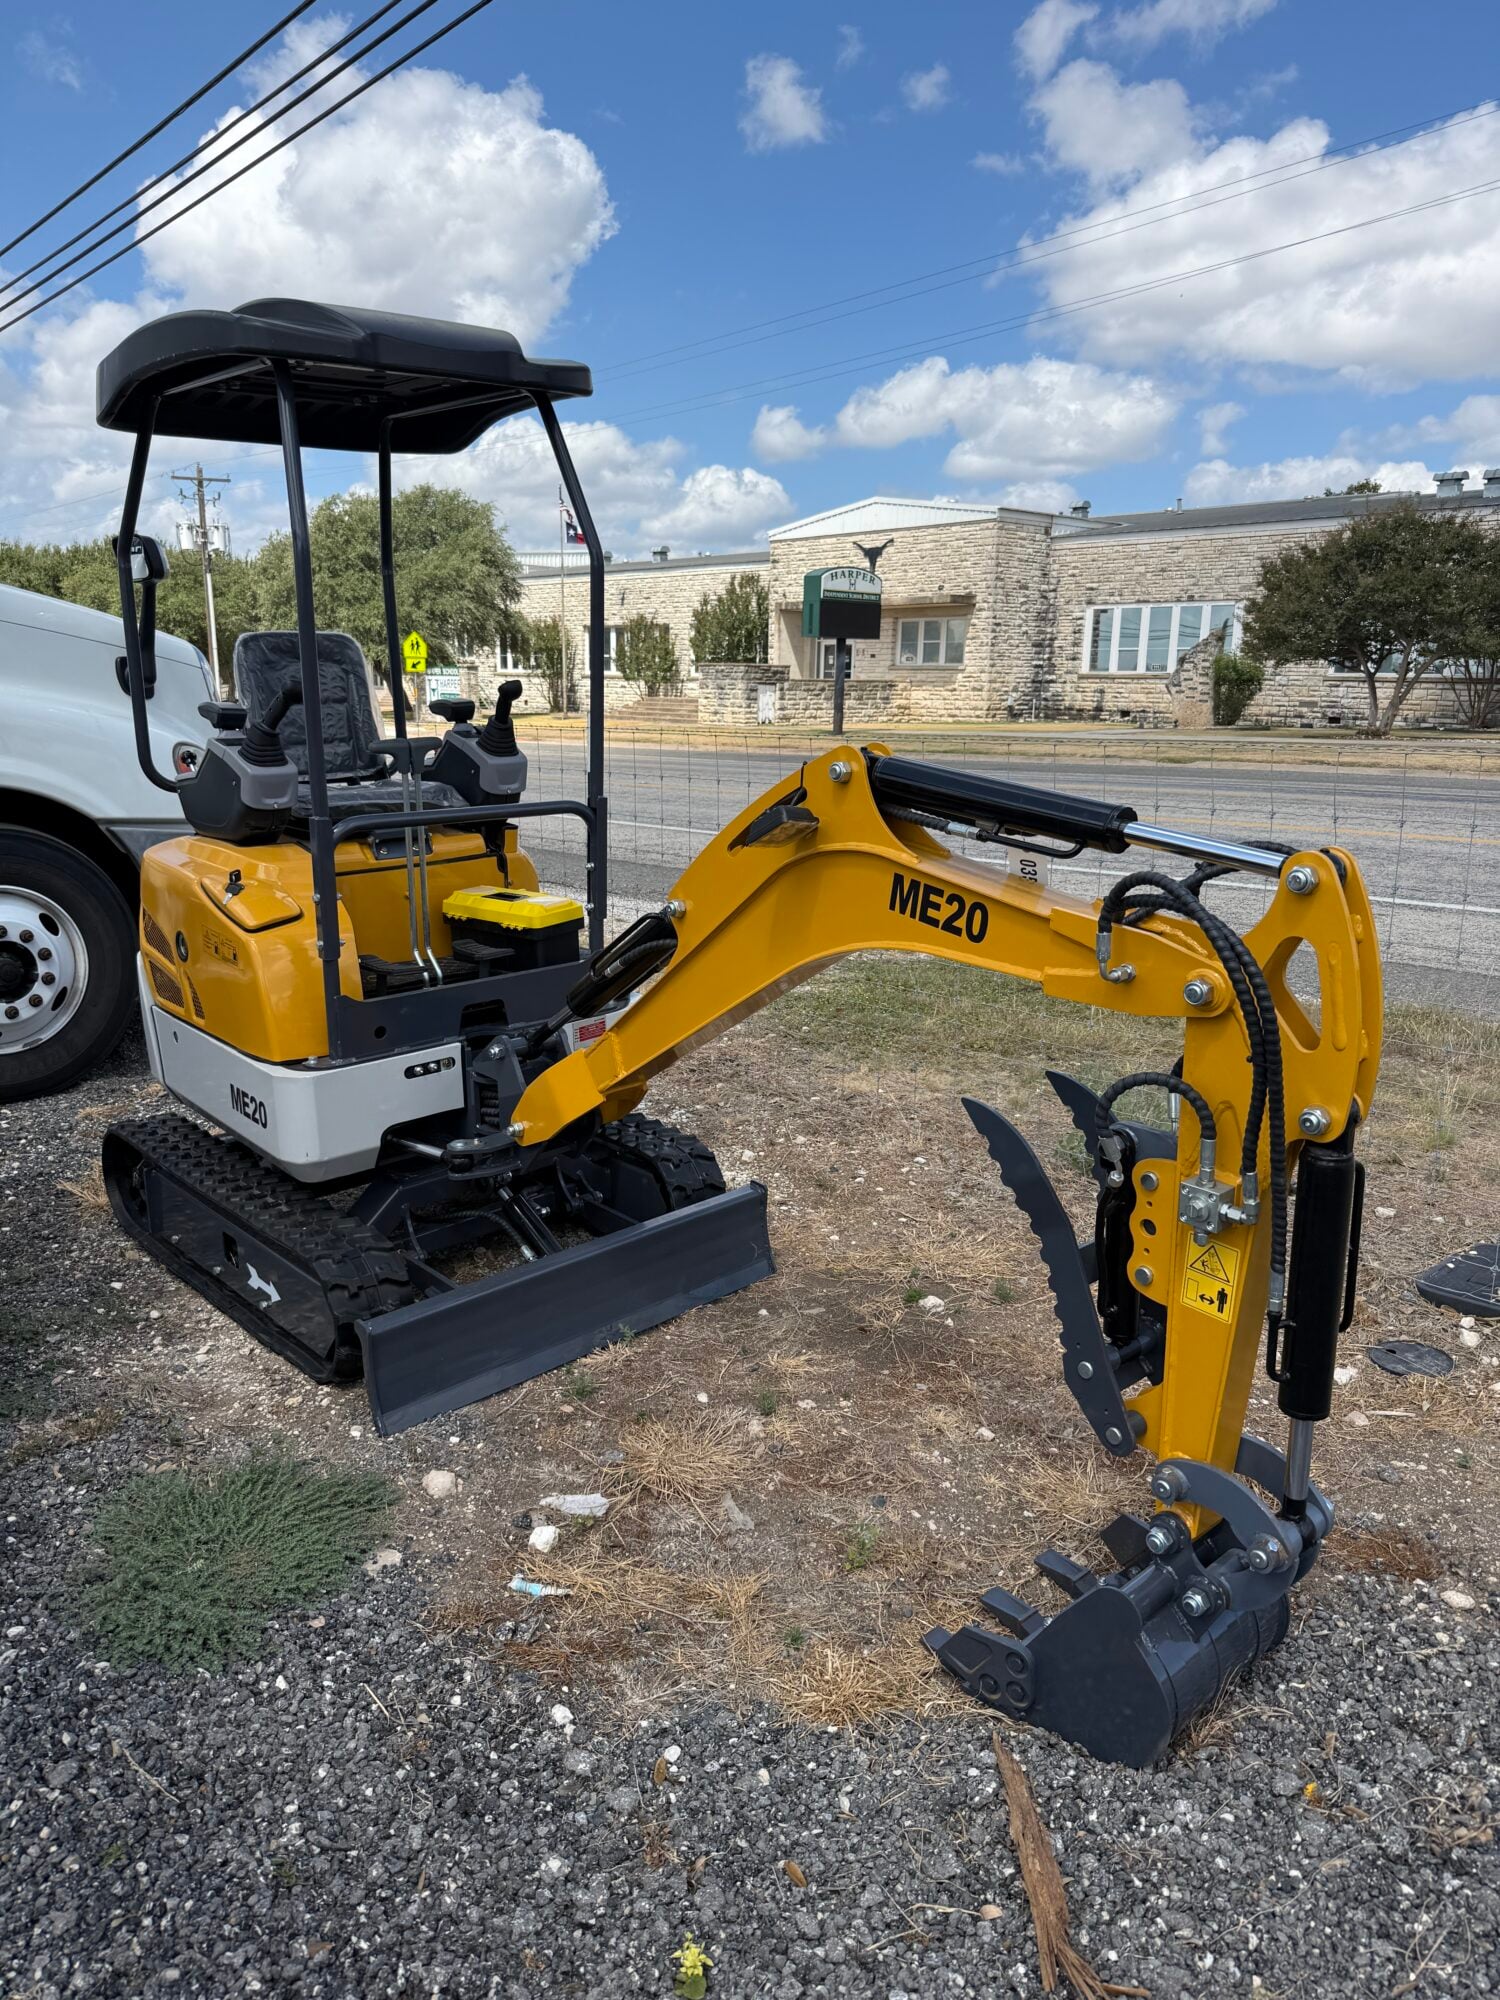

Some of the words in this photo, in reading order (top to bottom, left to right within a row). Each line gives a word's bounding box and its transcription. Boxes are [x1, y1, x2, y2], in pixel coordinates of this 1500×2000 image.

[830, 570, 876, 585] HARPER
[888, 872, 989, 944] ME20
[229, 1083, 268, 1129] ME20
